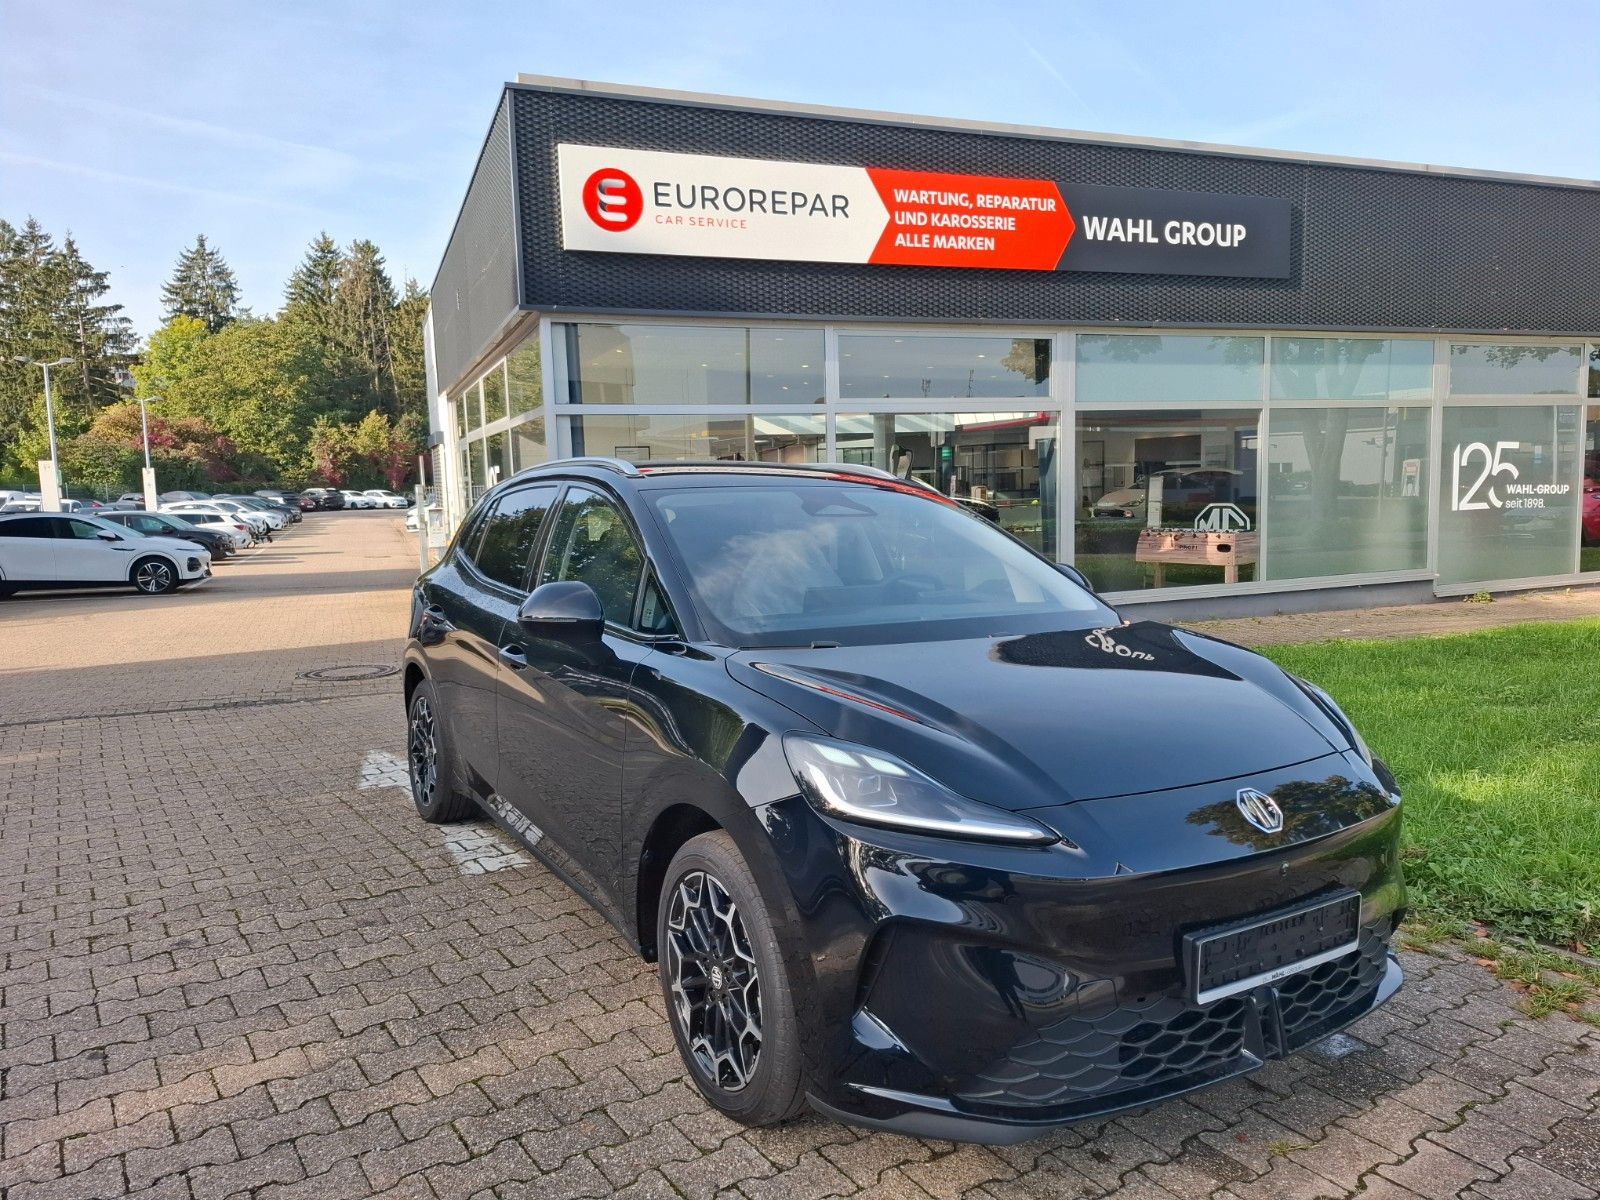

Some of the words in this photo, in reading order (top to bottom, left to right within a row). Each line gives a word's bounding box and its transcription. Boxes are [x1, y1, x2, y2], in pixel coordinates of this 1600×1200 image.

[654, 182, 849, 218] EUROREPAR
[893, 188, 973, 209] WARTUNG,
[977, 196, 1057, 213] REPARATUR
[655, 214, 684, 226] CAR
[689, 216, 748, 229] SERVICE
[894, 211, 926, 227] UND
[930, 214, 1017, 231] KAROSSERIE
[1083, 215, 1159, 243] WAHL
[1165, 221, 1247, 248] GROUP
[894, 234, 929, 248] ALLE
[933, 237, 996, 251] MARKEN
[1451, 441, 1520, 511] 125
[1506, 484, 1570, 495] WAHL-GROUP
[1505, 498, 1522, 508] seit
[1524, 498, 1546, 509] 1898.
